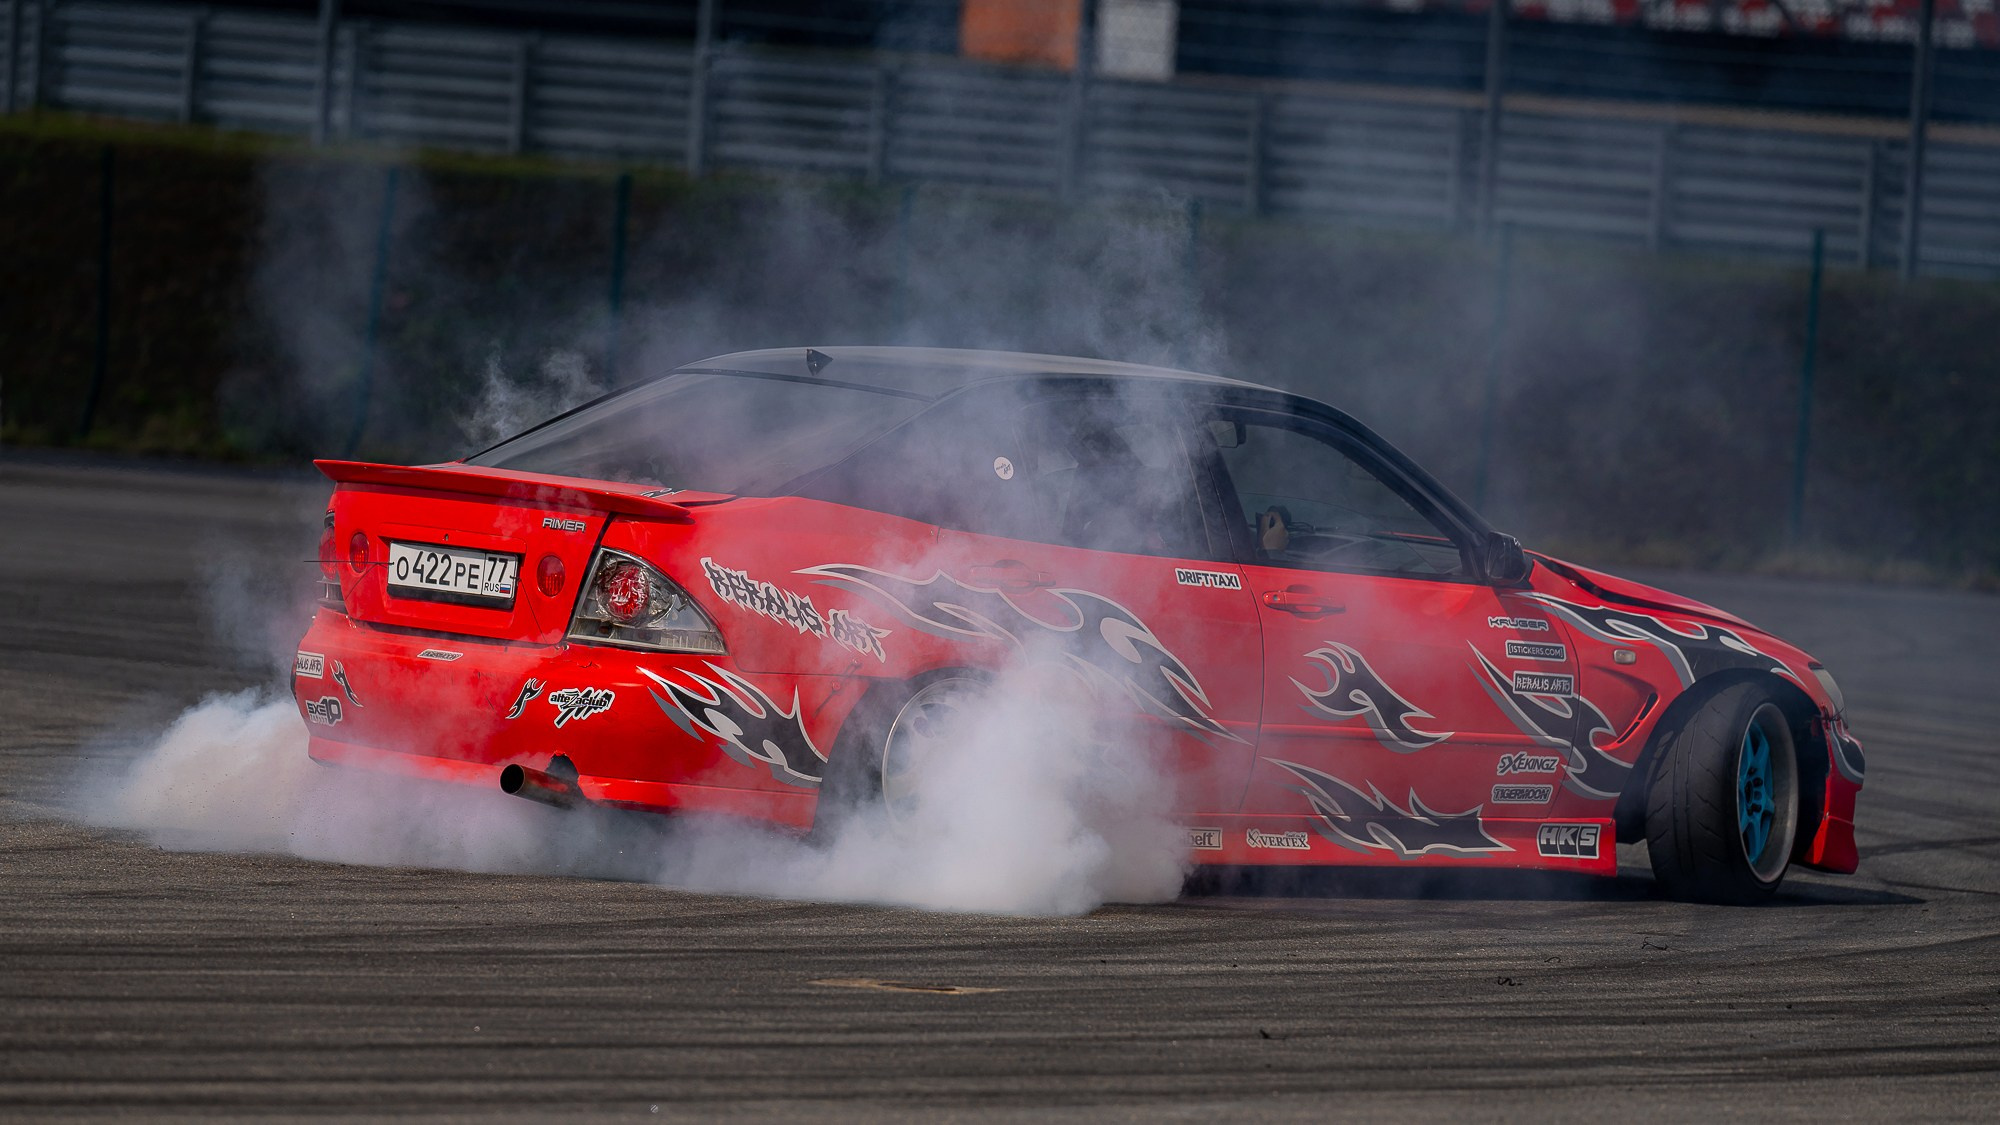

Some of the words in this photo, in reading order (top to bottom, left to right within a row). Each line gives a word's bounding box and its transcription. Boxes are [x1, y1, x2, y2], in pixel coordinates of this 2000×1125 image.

[542, 518, 586, 533] RIMER
[487, 557, 508, 583] 77
[483, 582, 500, 593] RUS
[1488, 617, 1548, 630] KRUGER
[1260, 835, 1309, 848] VERTEX
[1540, 826, 1597, 846] HKS
